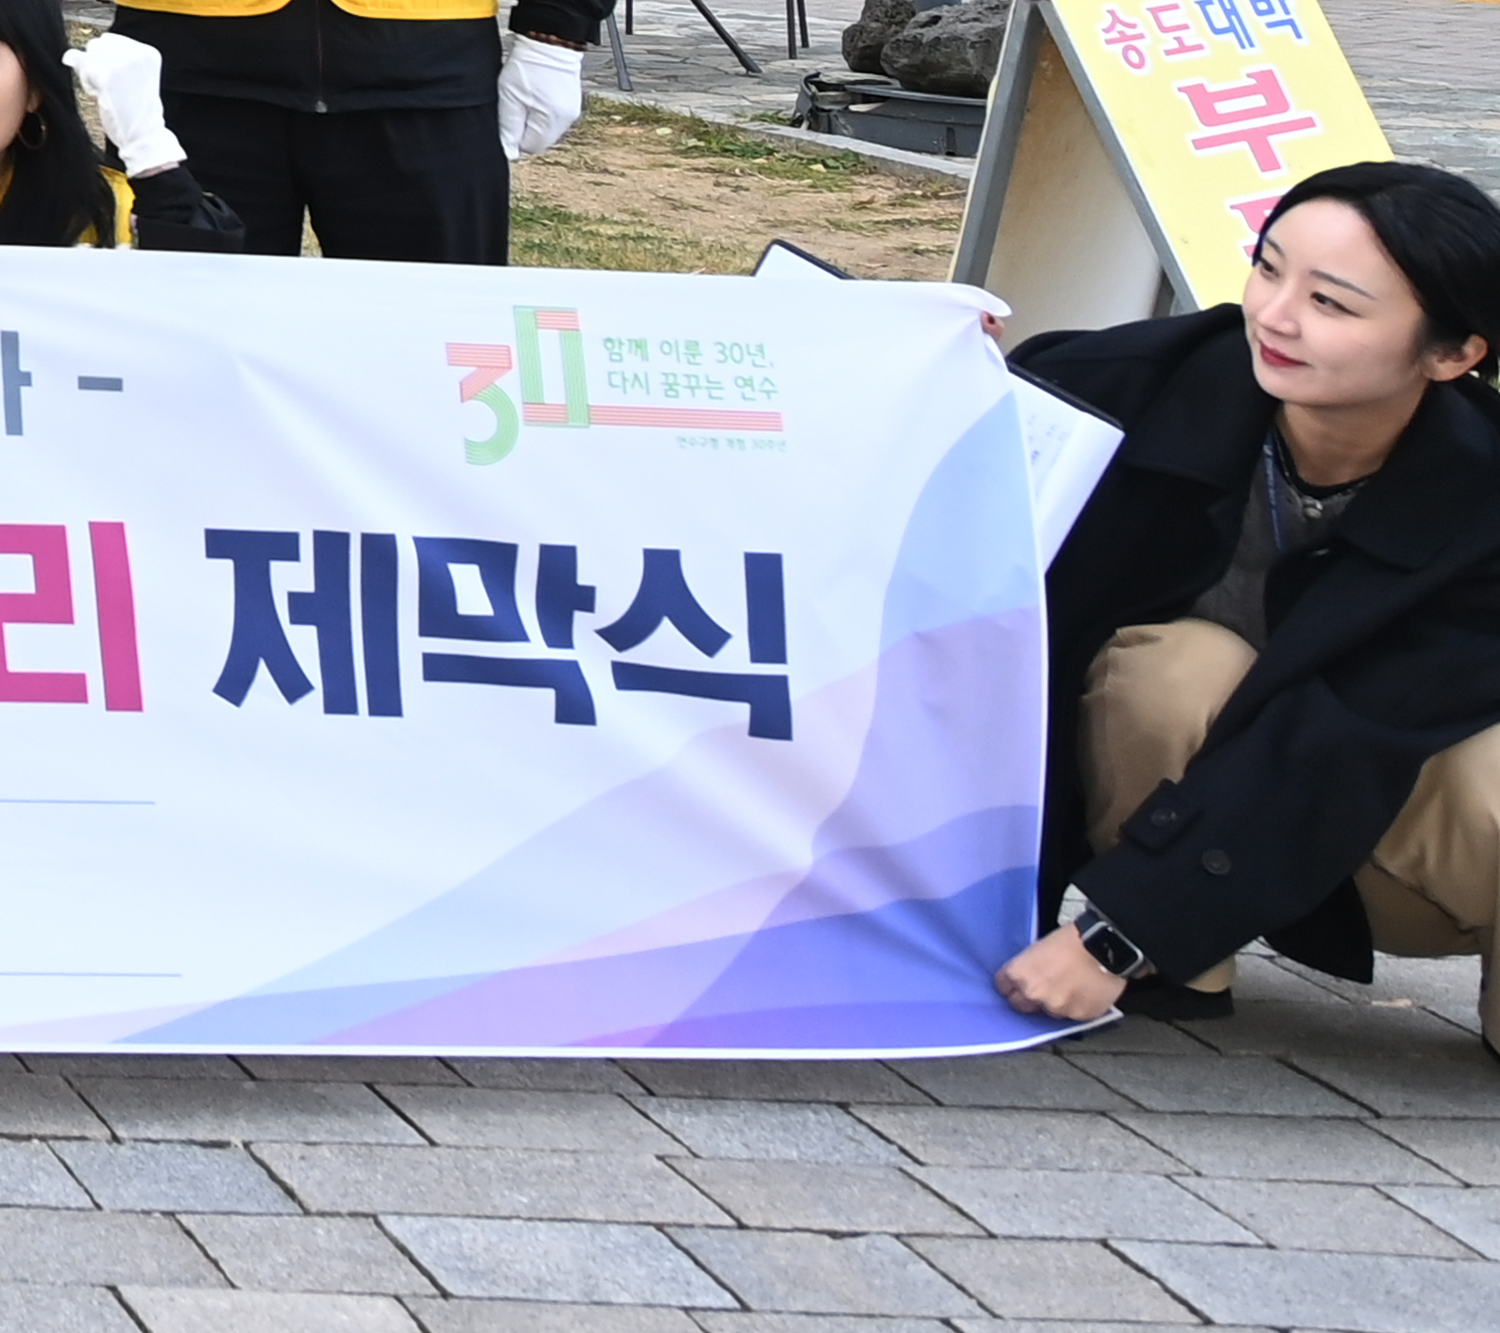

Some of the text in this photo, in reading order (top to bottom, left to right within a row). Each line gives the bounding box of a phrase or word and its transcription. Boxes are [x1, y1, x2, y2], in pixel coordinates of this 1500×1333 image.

[602, 336, 650, 363] 함께
[607, 370, 779, 401] 다시 꿈꾸는 연수
[203, 527, 794, 743] 제막식
